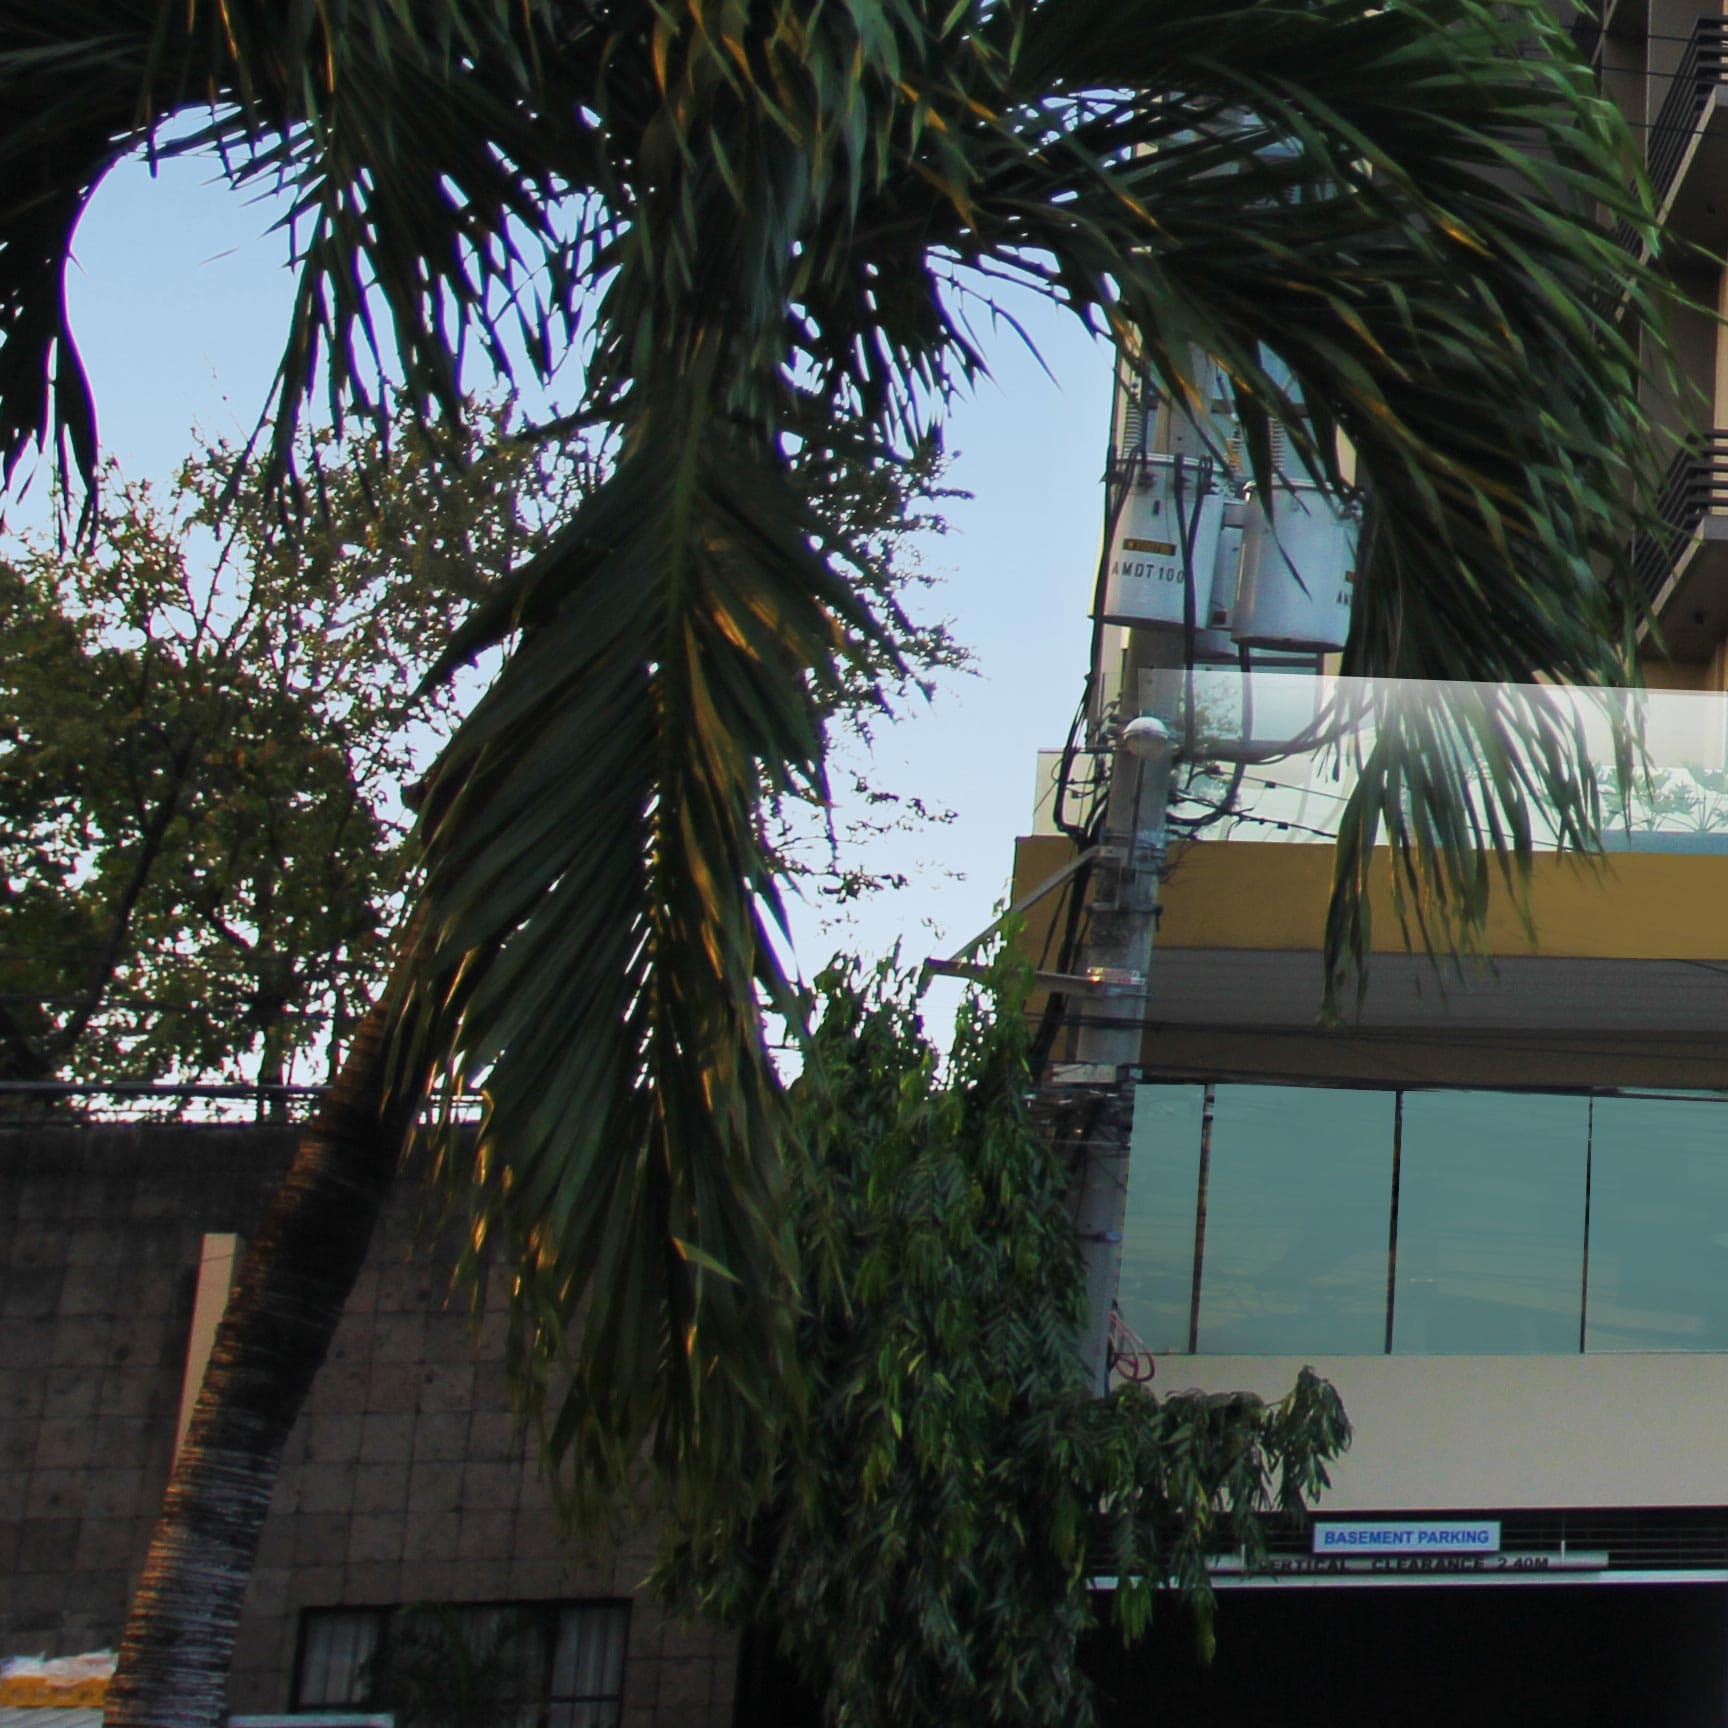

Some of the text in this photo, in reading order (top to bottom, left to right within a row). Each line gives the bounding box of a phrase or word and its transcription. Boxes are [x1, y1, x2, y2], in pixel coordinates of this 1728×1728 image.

[1323, 1529, 1491, 1546] BASEMENT PARKING
[1371, 1557, 1486, 1571] CLEARANCE
